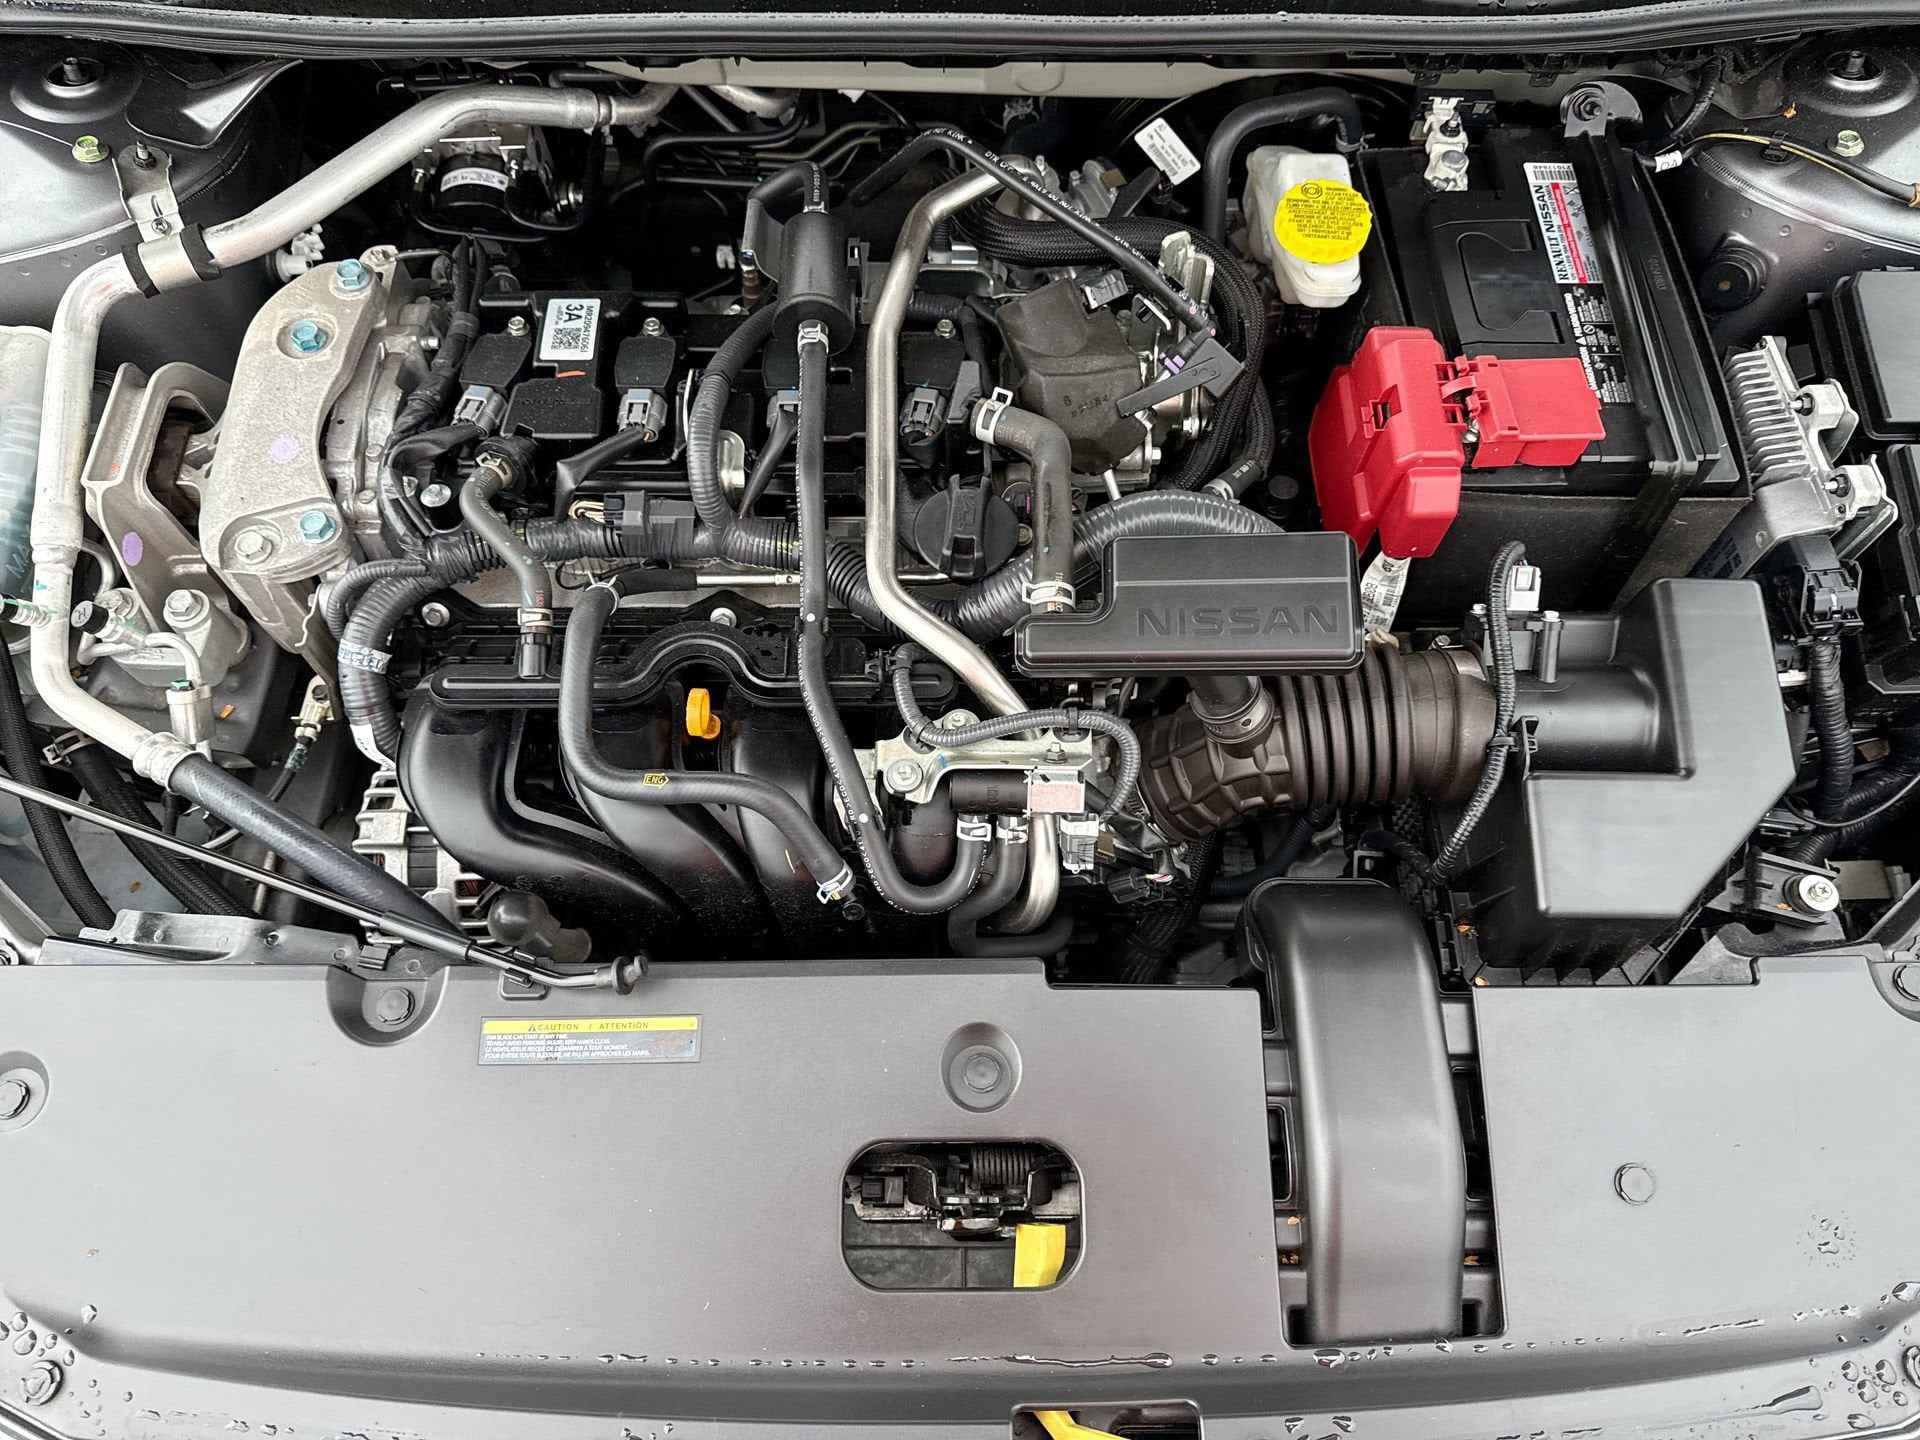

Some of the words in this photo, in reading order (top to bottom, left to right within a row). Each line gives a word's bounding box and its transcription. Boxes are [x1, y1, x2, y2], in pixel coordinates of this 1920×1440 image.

[1533, 184, 1556, 232] NISSAN
[1548, 236, 1570, 280] RENAULT
[564, 304, 584, 323] 3A
[1138, 606, 1338, 636] NISSAN
[646, 775, 664, 784] ENG
